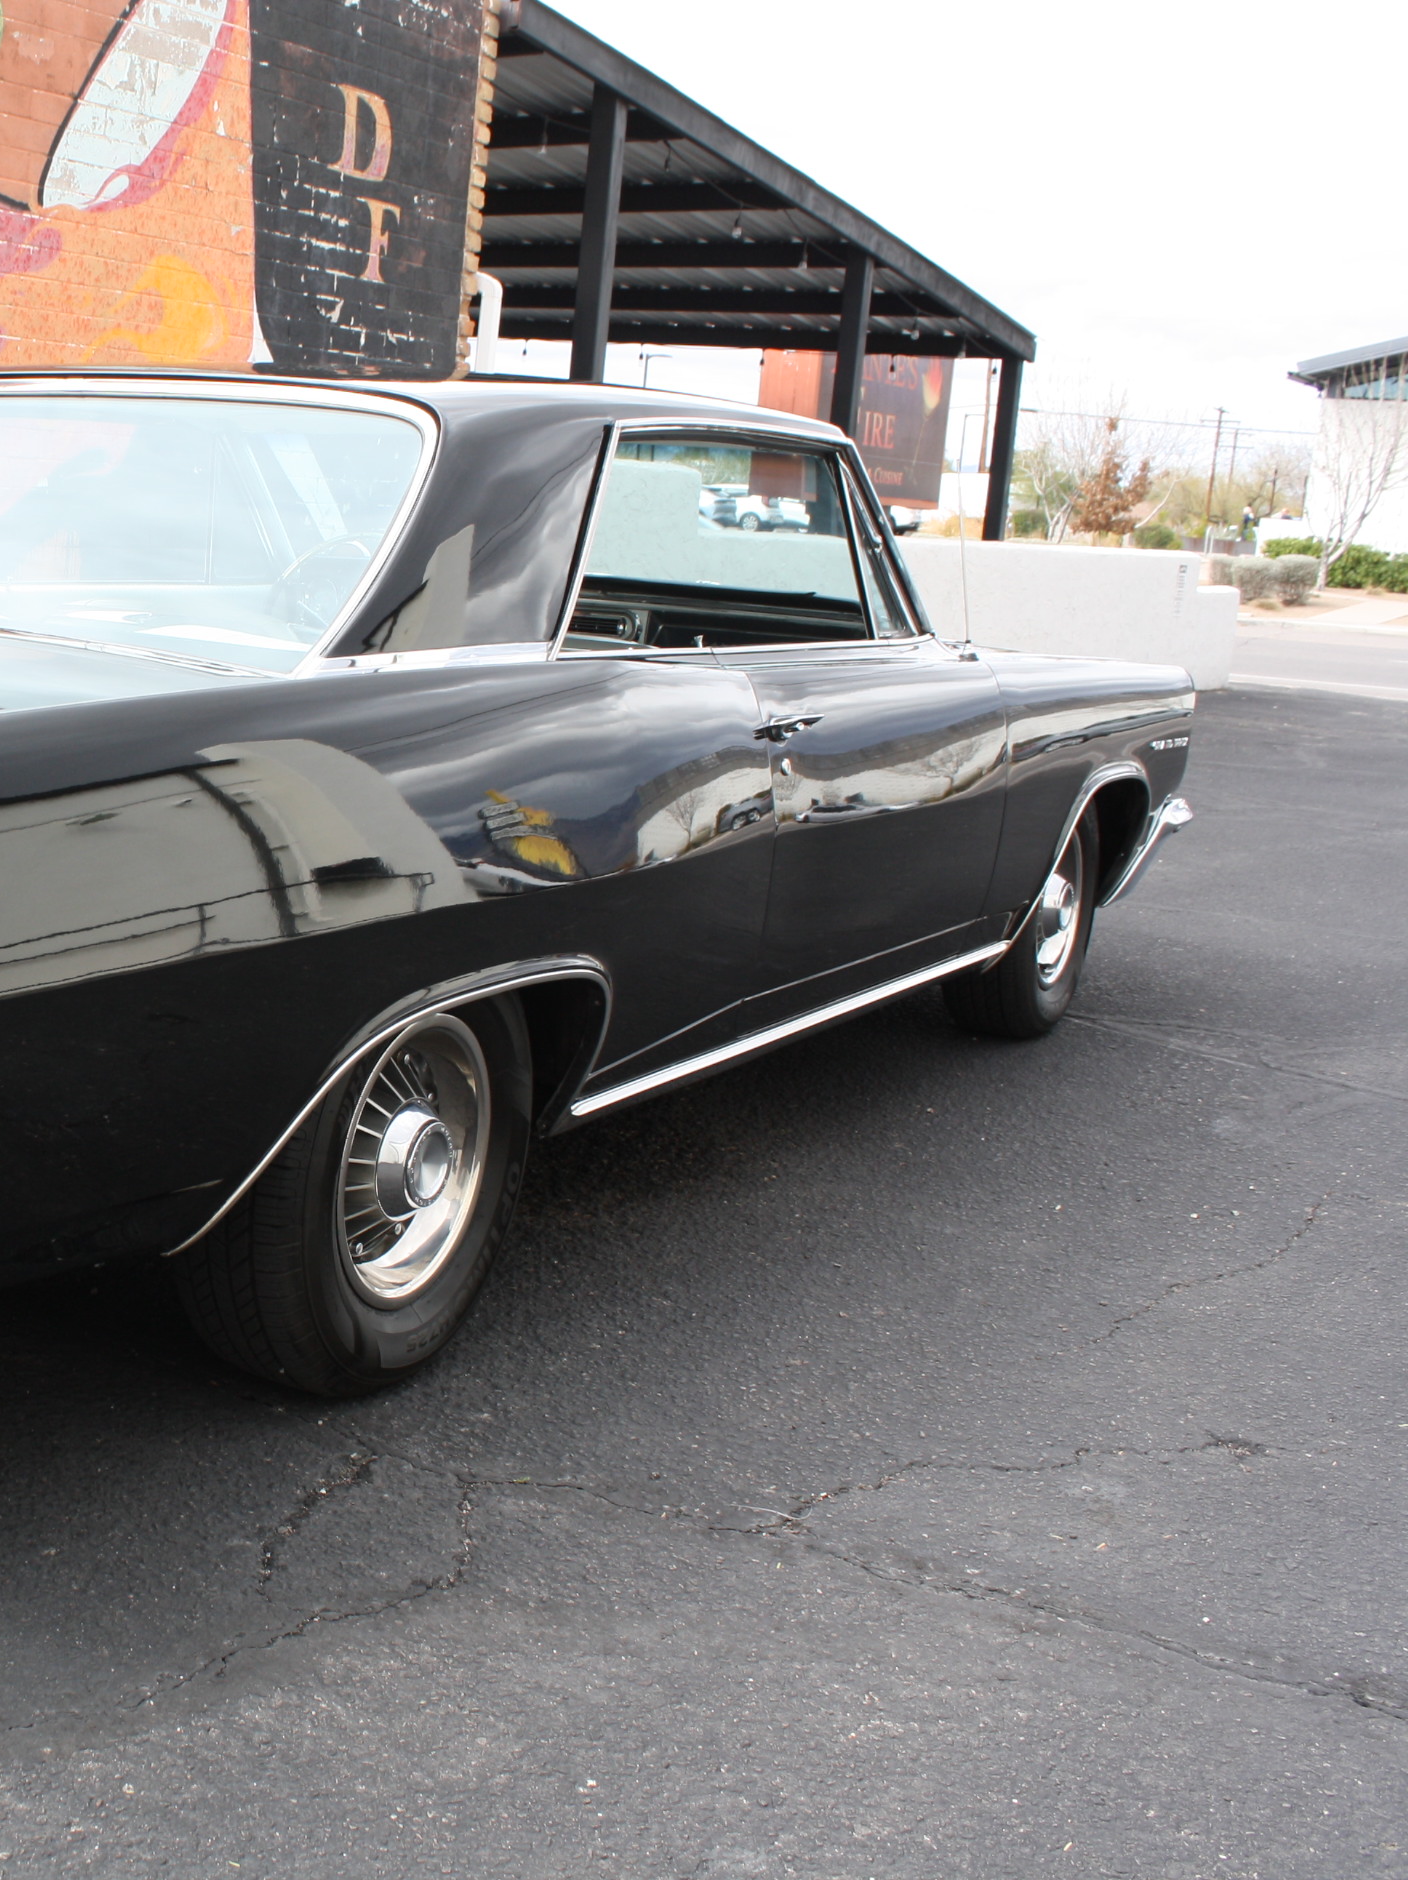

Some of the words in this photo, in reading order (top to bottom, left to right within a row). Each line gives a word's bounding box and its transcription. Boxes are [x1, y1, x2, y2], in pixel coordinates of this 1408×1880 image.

[327, 83, 392, 182] D
[356, 196, 401, 284] F
[857, 406, 896, 449] IRE
